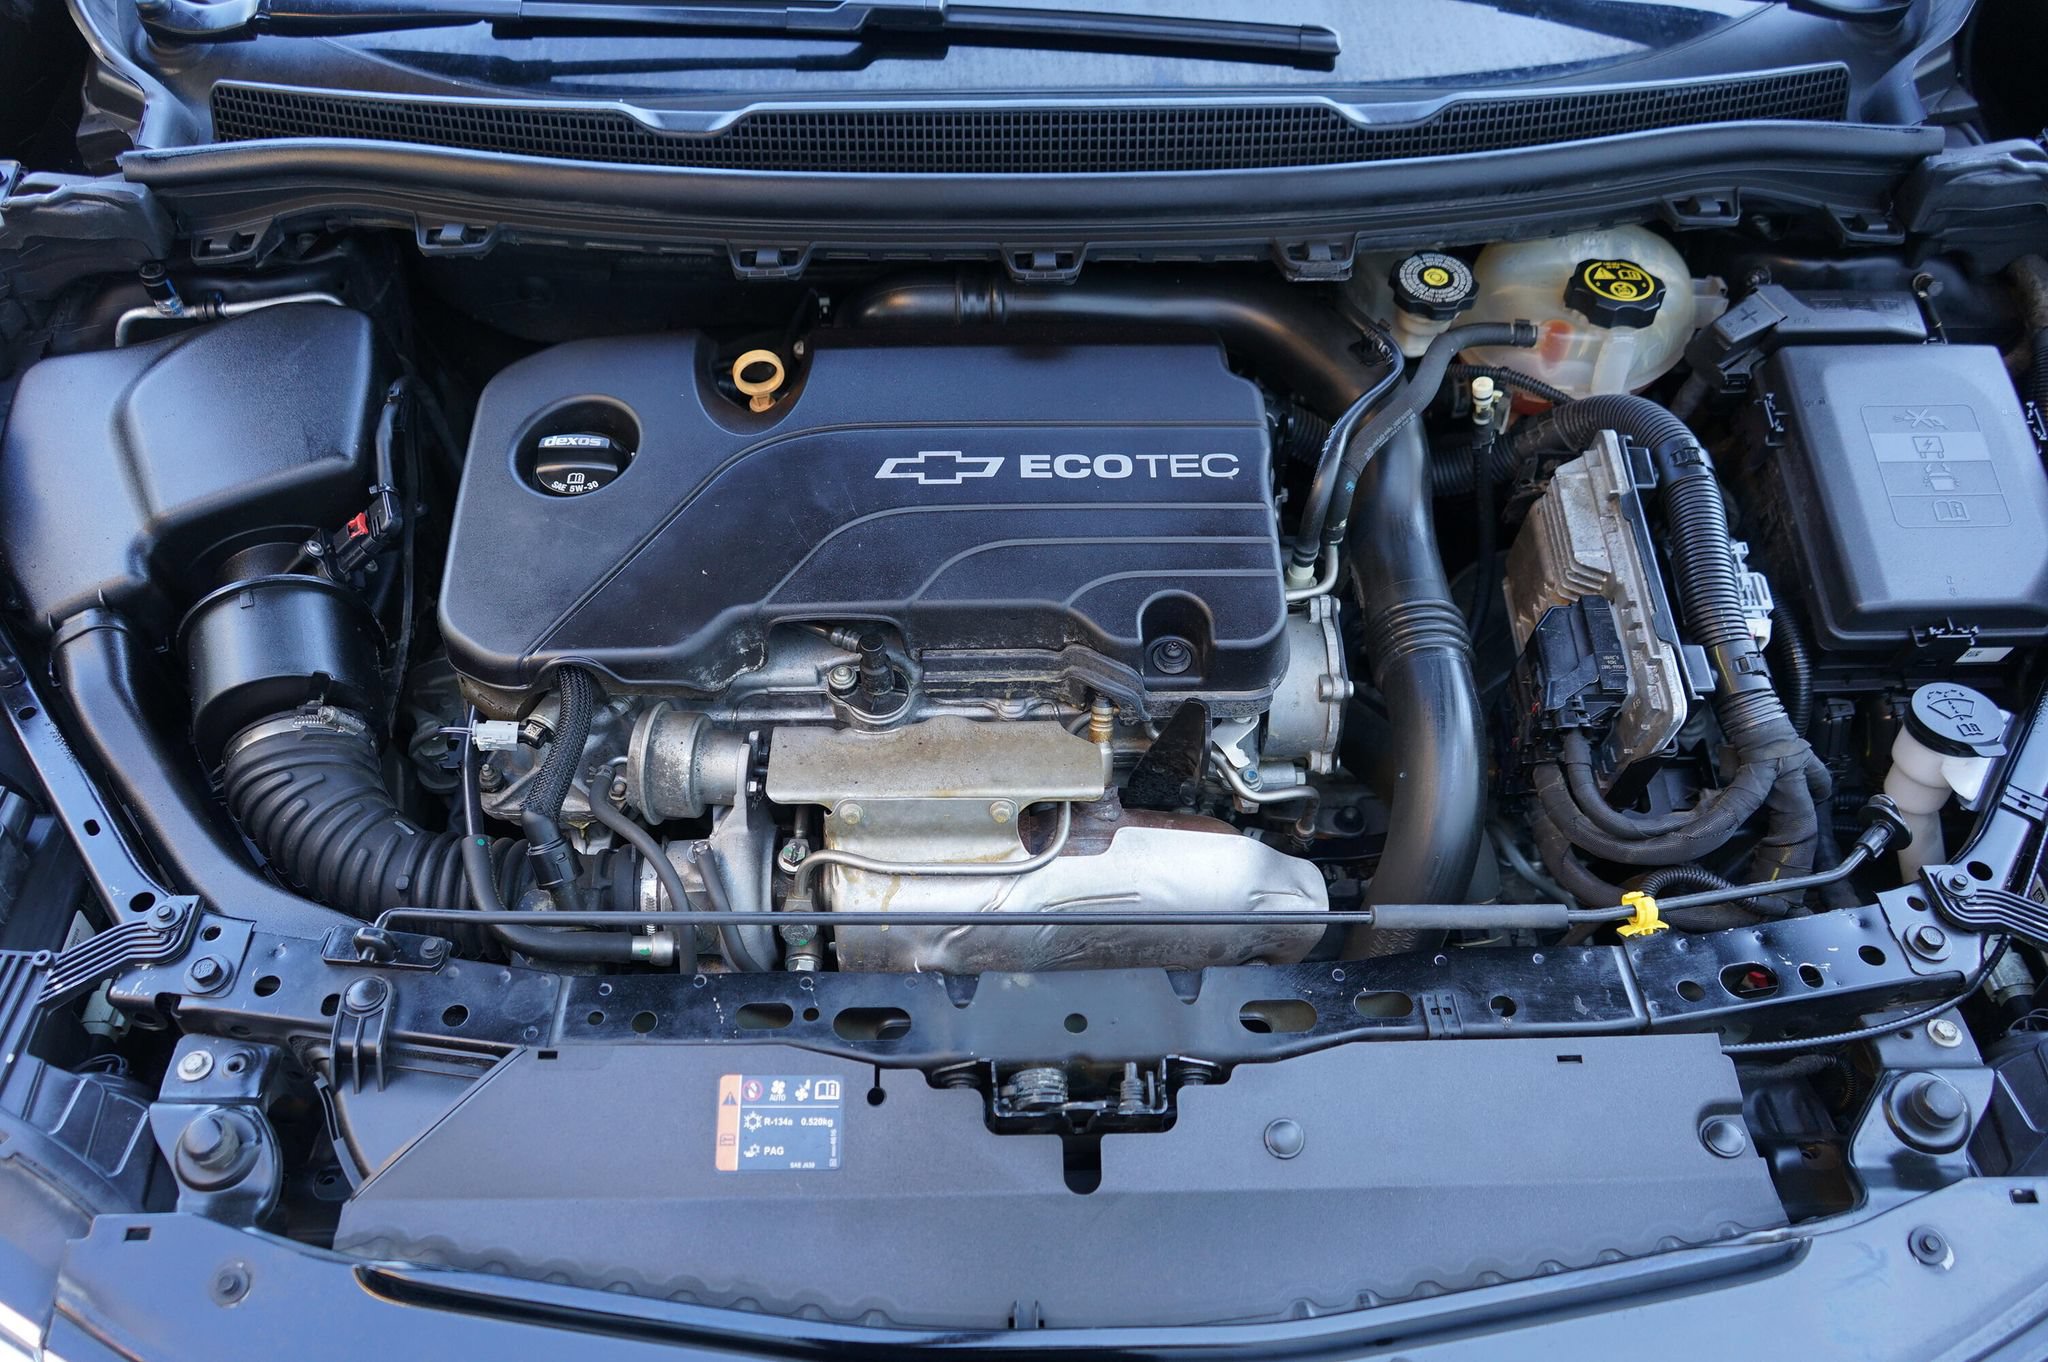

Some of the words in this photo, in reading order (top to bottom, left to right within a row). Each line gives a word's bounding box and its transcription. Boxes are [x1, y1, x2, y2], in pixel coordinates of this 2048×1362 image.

[544, 436, 601, 447] dexos
[1020, 453, 1240, 479] ECOTEC
[551, 481, 567, 491] SAE
[569, 480, 599, 492] 5W-30
[763, 1146, 784, 1156] PAG
